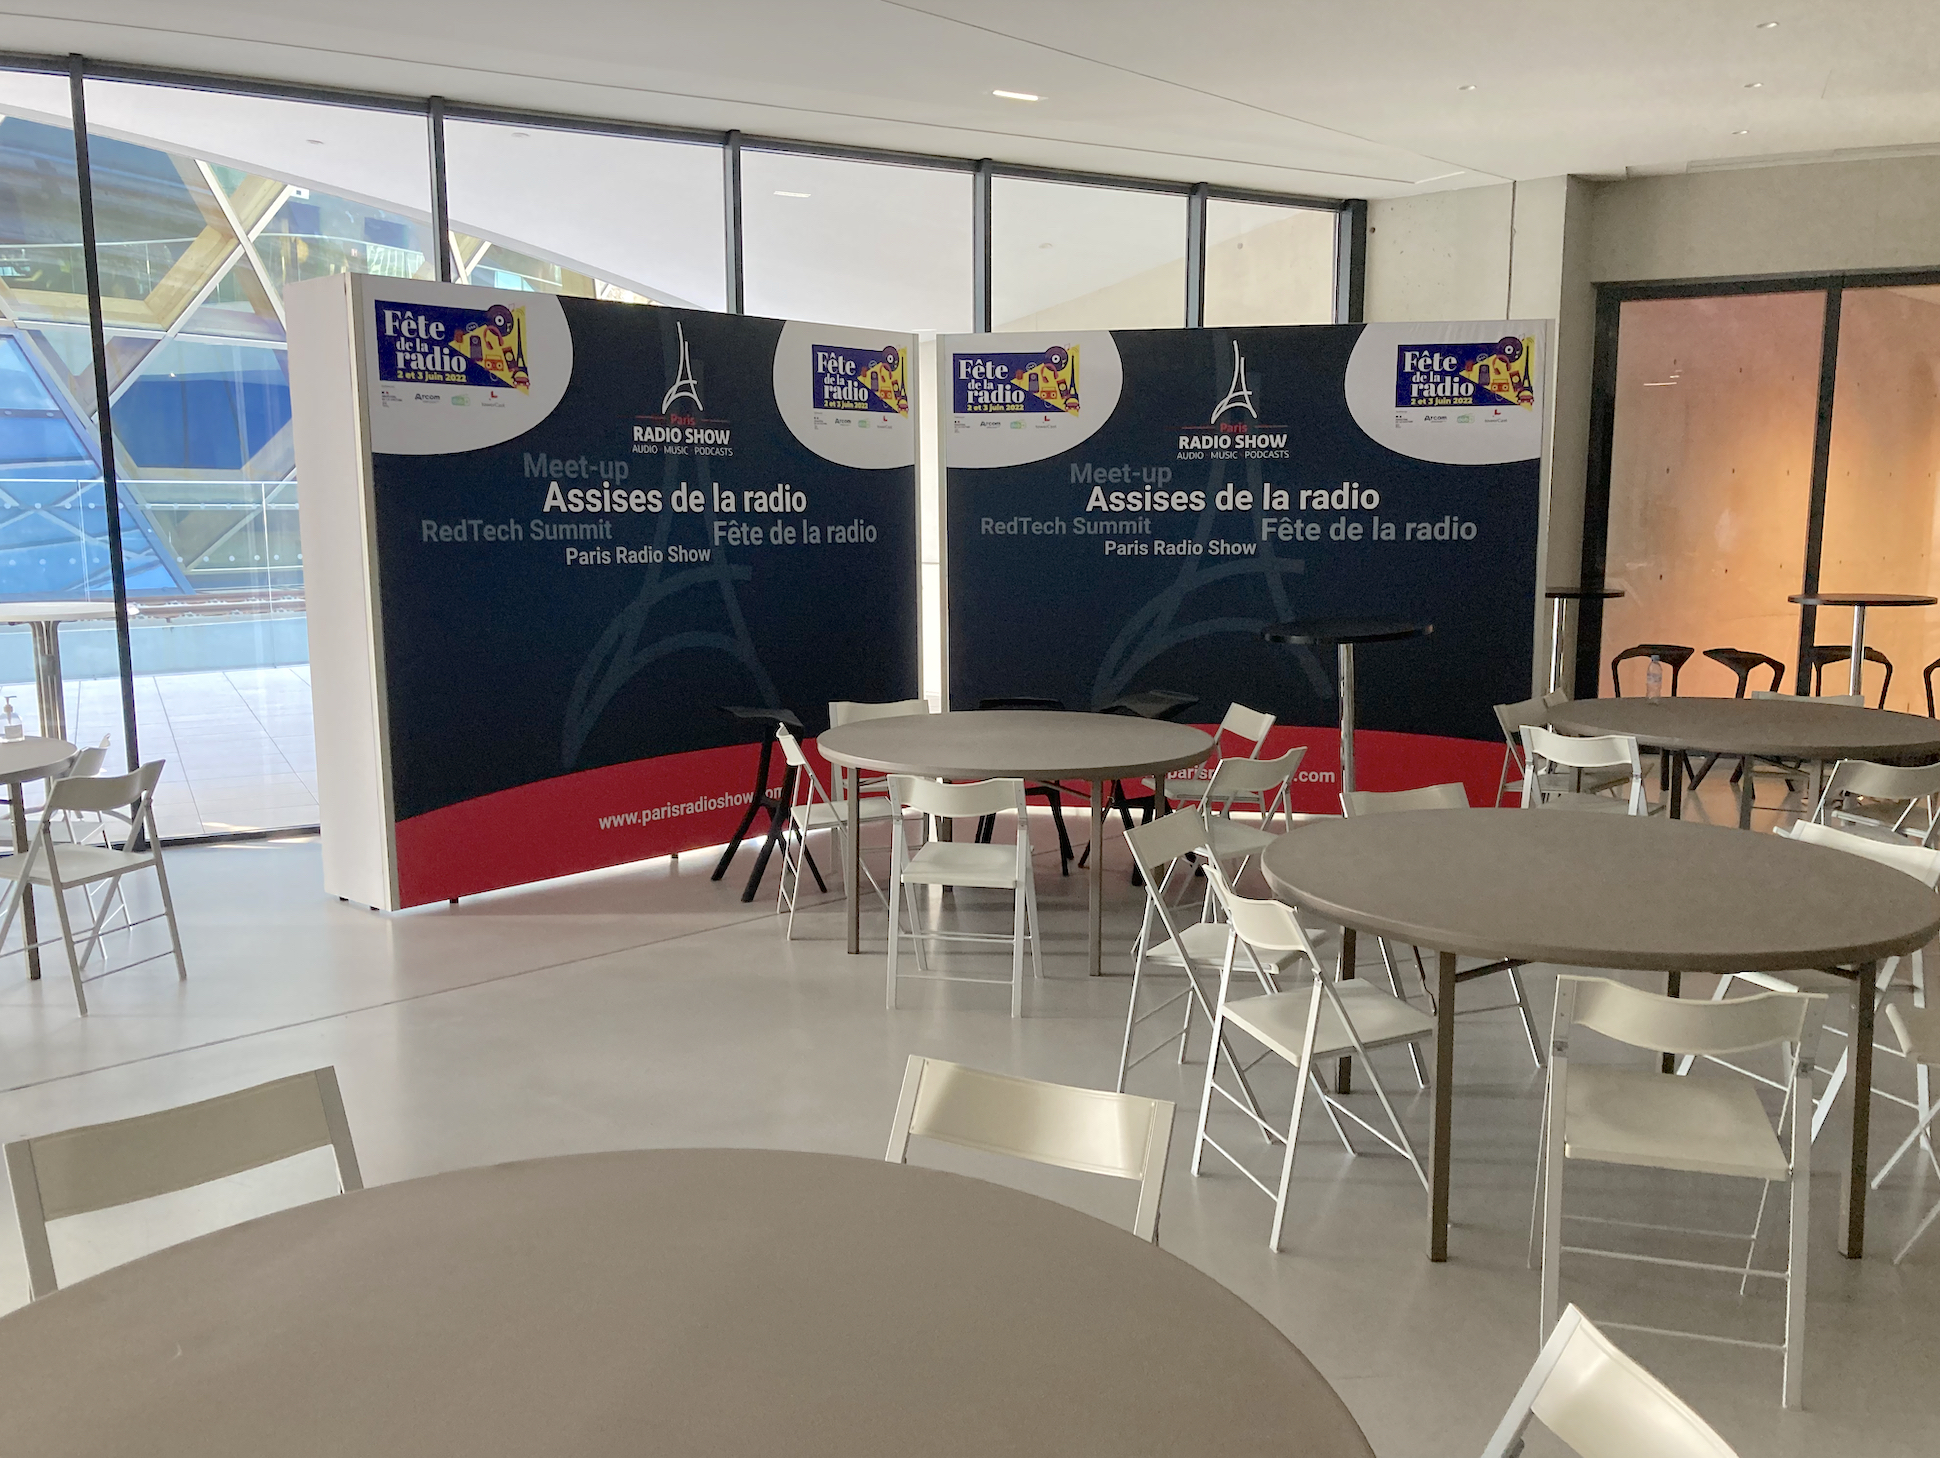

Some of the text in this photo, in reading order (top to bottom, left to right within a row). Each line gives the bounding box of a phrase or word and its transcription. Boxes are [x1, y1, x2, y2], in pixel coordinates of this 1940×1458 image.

[383, 309, 445, 340] Fête
[396, 337, 429, 353] de la
[396, 346, 467, 373] radio
[817, 351, 856, 376] Fête
[959, 359, 1009, 380] Fête
[1403, 350, 1458, 372] Fête
[397, 371, 467, 383] 2 et 3 juin 2022
[824, 373, 845, 386] de la
[967, 379, 994, 390] de la
[1410, 376, 1475, 398] radio
[1412, 371, 1441, 383] de la
[824, 380, 869, 402] radio
[967, 384, 1025, 404] radio
[989, 404, 1004, 412] juin
[1435, 397, 1451, 406] juin
[670, 413, 696, 426] Paris
[1220, 422, 1248, 433] Paris
[633, 426, 731, 445] RADIO SHOW
[1179, 434, 1287, 450] RADIO SHOW
[632, 444, 733, 456] AUDIO MUSIC PODCASTS
[1176, 450, 1290, 460] AUDIO MUSIC PODCASTS
[523, 452, 629, 486] Meet-up
[1070, 463, 1172, 488] Meet-up
[542, 480, 807, 513] Assises de la radio
[1085, 482, 1380, 512] Assises de la radio
[421, 517, 613, 543] RedTech Summit
[713, 519, 877, 546] Fête de la radio
[980, 516, 1151, 535] RedTech Summit
[1261, 515, 1478, 541] Fête de la radio
[565, 545, 711, 566] Paris Radio Show
[1104, 539, 1257, 556] Paris Radio Show
